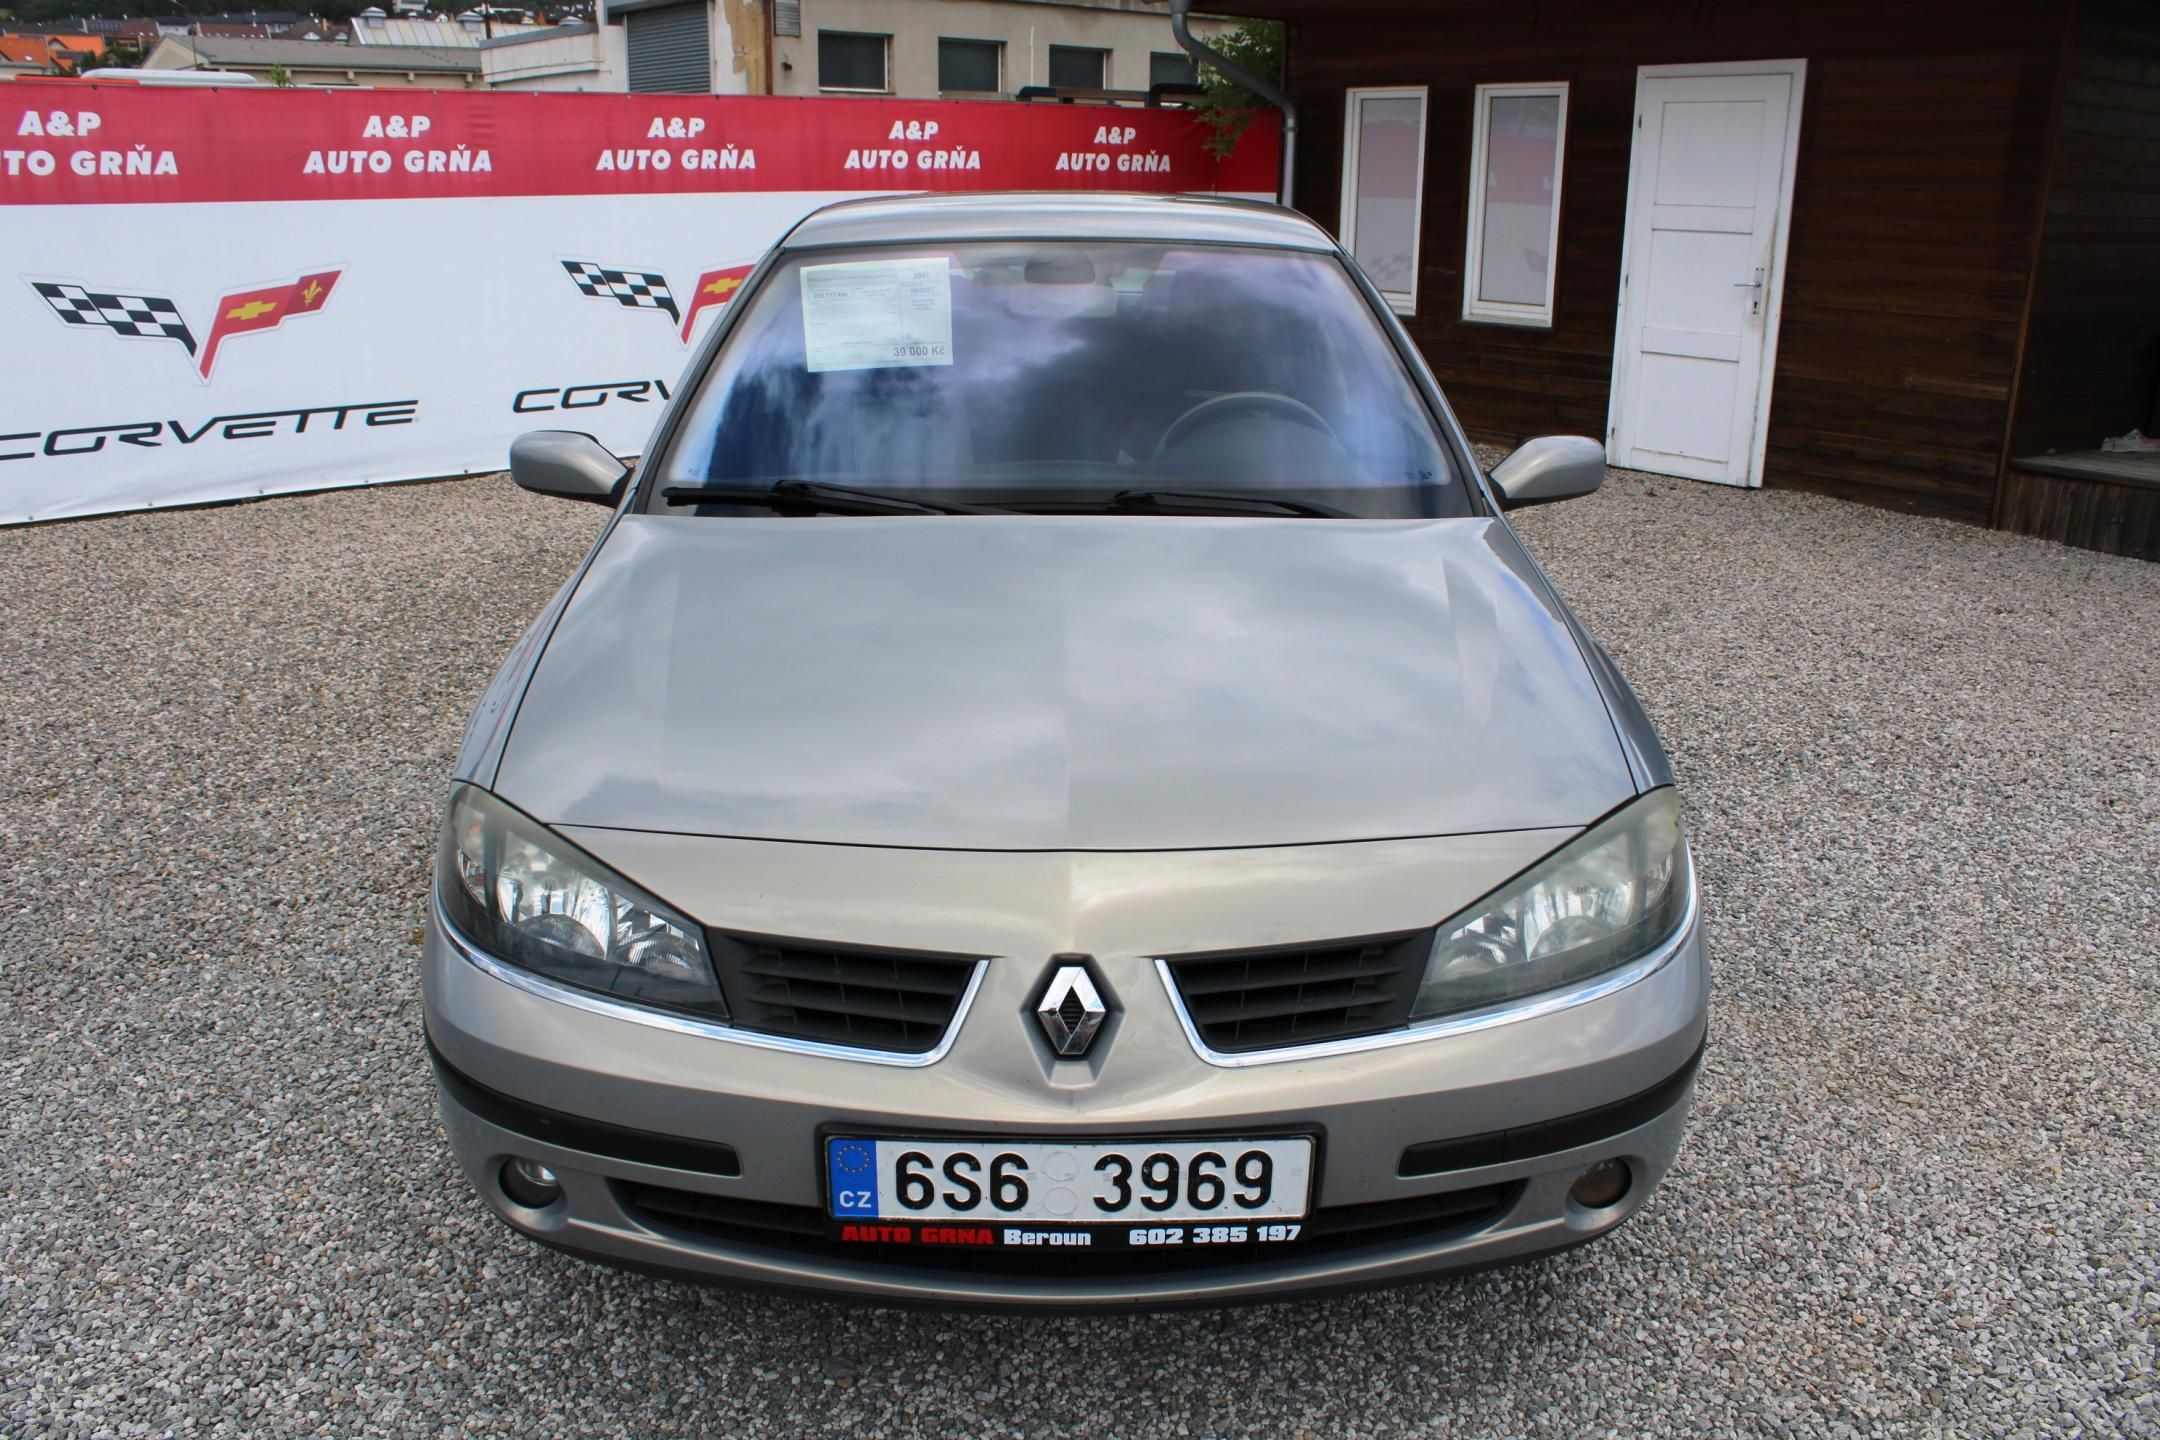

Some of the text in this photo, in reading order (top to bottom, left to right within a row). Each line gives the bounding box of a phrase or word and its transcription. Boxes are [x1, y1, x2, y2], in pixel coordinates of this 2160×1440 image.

[17, 110, 101, 137] A&P
[362, 115, 431, 138] A&P
[647, 117, 706, 138] A&P
[888, 120, 939, 140] A&P
[1093, 126, 1137, 144] A&P
[0, 143, 179, 176] TO GRŇA
[302, 143, 493, 174] AUTO GRŇA
[595, 143, 757, 171] AUTO GRŇA
[843, 145, 981, 170] AUTO GRŇA
[1055, 149, 1171, 173] AUTO GRŇA
[893, 345, 945, 357] 39 000 Kč
[0, 400, 419, 461] CORVETTE
[895, 1150, 1274, 1213] 6S6 3969
[839, 1190, 872, 1208] CZ
[841, 1225, 1301, 1246] AUTO GRNA Beroun 602 385 197
